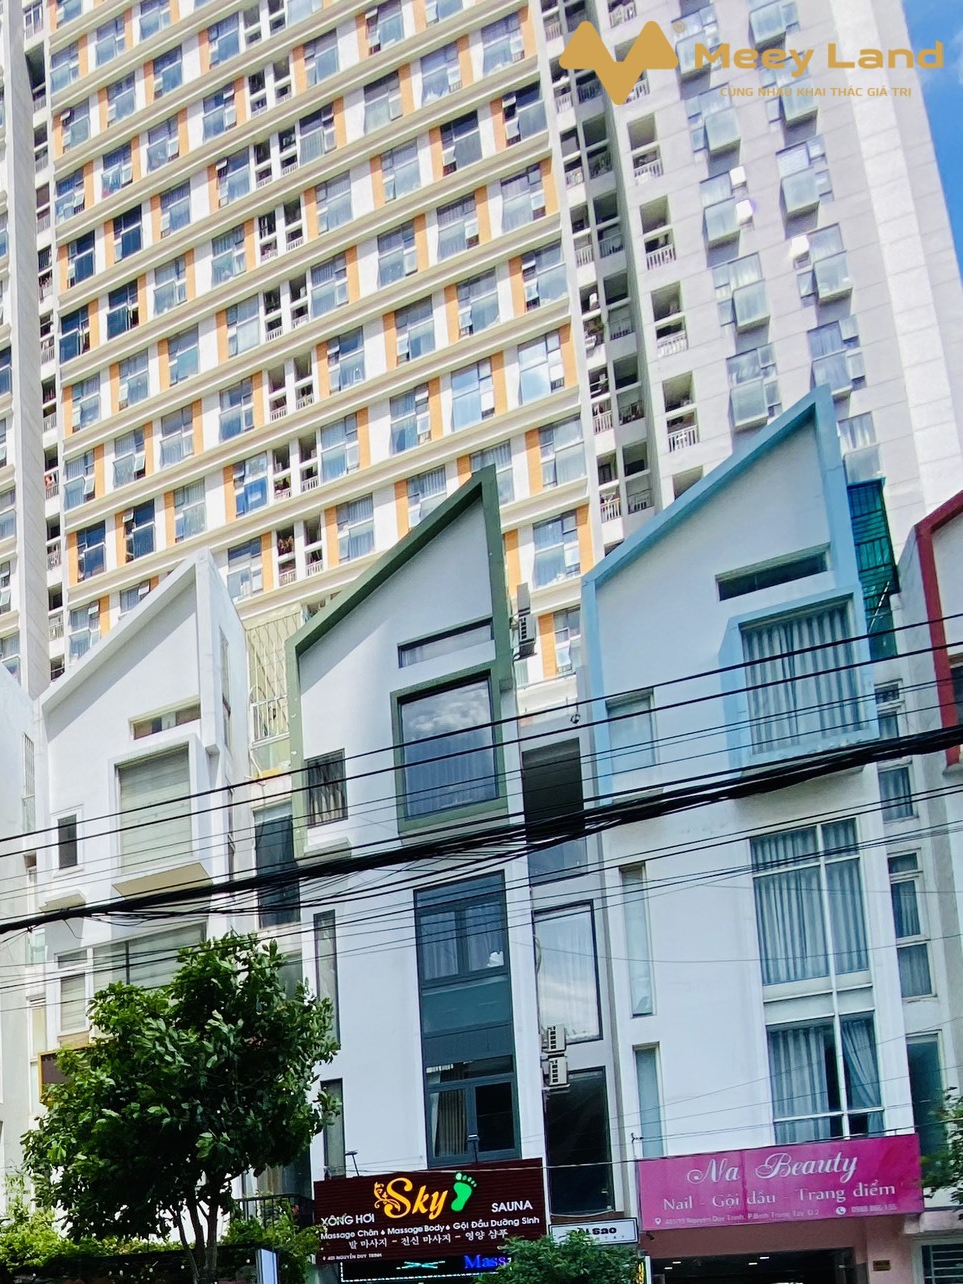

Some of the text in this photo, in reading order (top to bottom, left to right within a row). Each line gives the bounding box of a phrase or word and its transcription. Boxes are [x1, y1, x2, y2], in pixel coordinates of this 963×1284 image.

[755, 1152, 858, 1183] Beauty
[379, 1177, 448, 1220] Sky
[663, 1195, 693, 1211] Nail
[712, 1192, 739, 1208] Gội
[794, 1187, 846, 1203] Trang
[356, 1213, 375, 1224] HƠI
[491, 1200, 533, 1213] SAUNA
[321, 1231, 355, 1241] Massage
[387, 1226, 423, 1235] Massage
[423, 1224, 445, 1233] Body
[521, 1216, 540, 1225] Sinh
[360, 1238, 388, 1249] 마사지
[422, 1233, 451, 1244] 마사지
